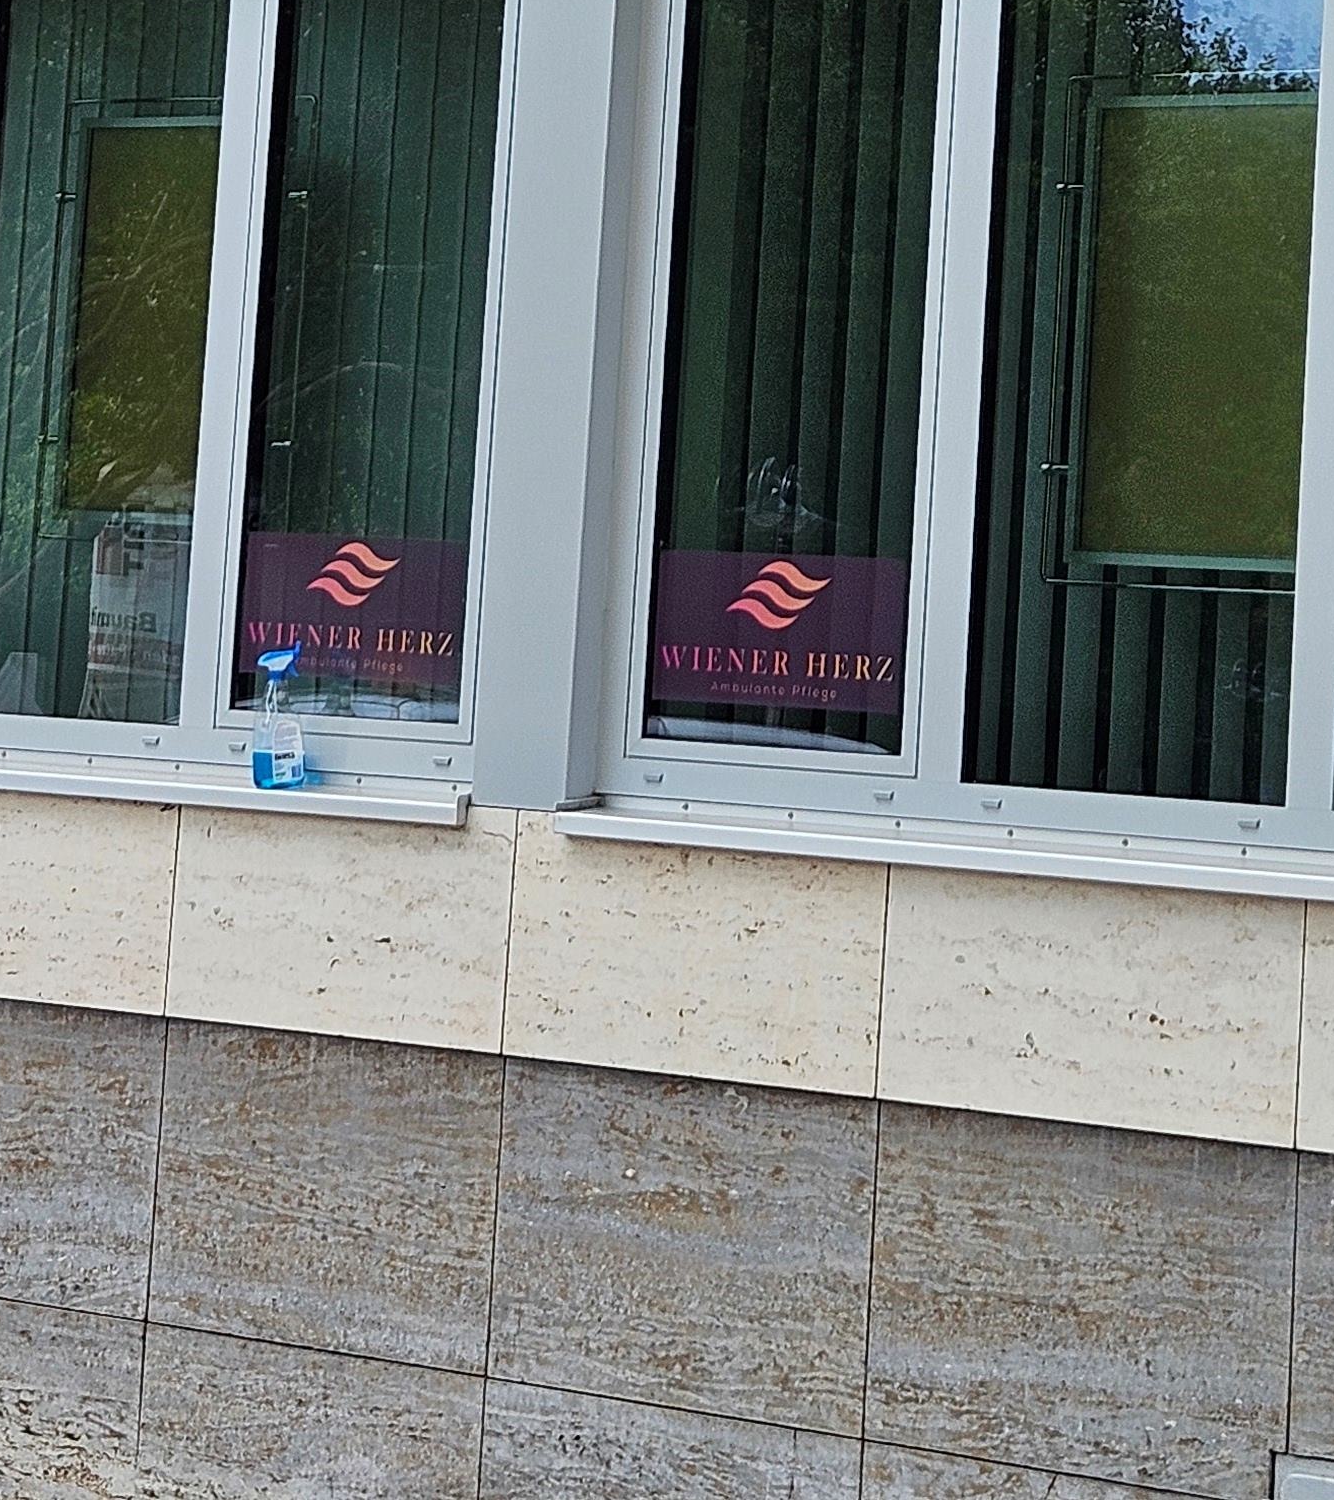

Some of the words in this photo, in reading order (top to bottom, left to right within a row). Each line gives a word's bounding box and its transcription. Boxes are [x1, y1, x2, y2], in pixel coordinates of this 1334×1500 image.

[249, 621, 362, 648] WIENER
[378, 628, 456, 655] HERZ
[662, 646, 788, 675] WIENER
[807, 653, 894, 681] HERZ
[710, 682, 786, 696] Ambulante
[791, 685, 838, 702] Pflege
